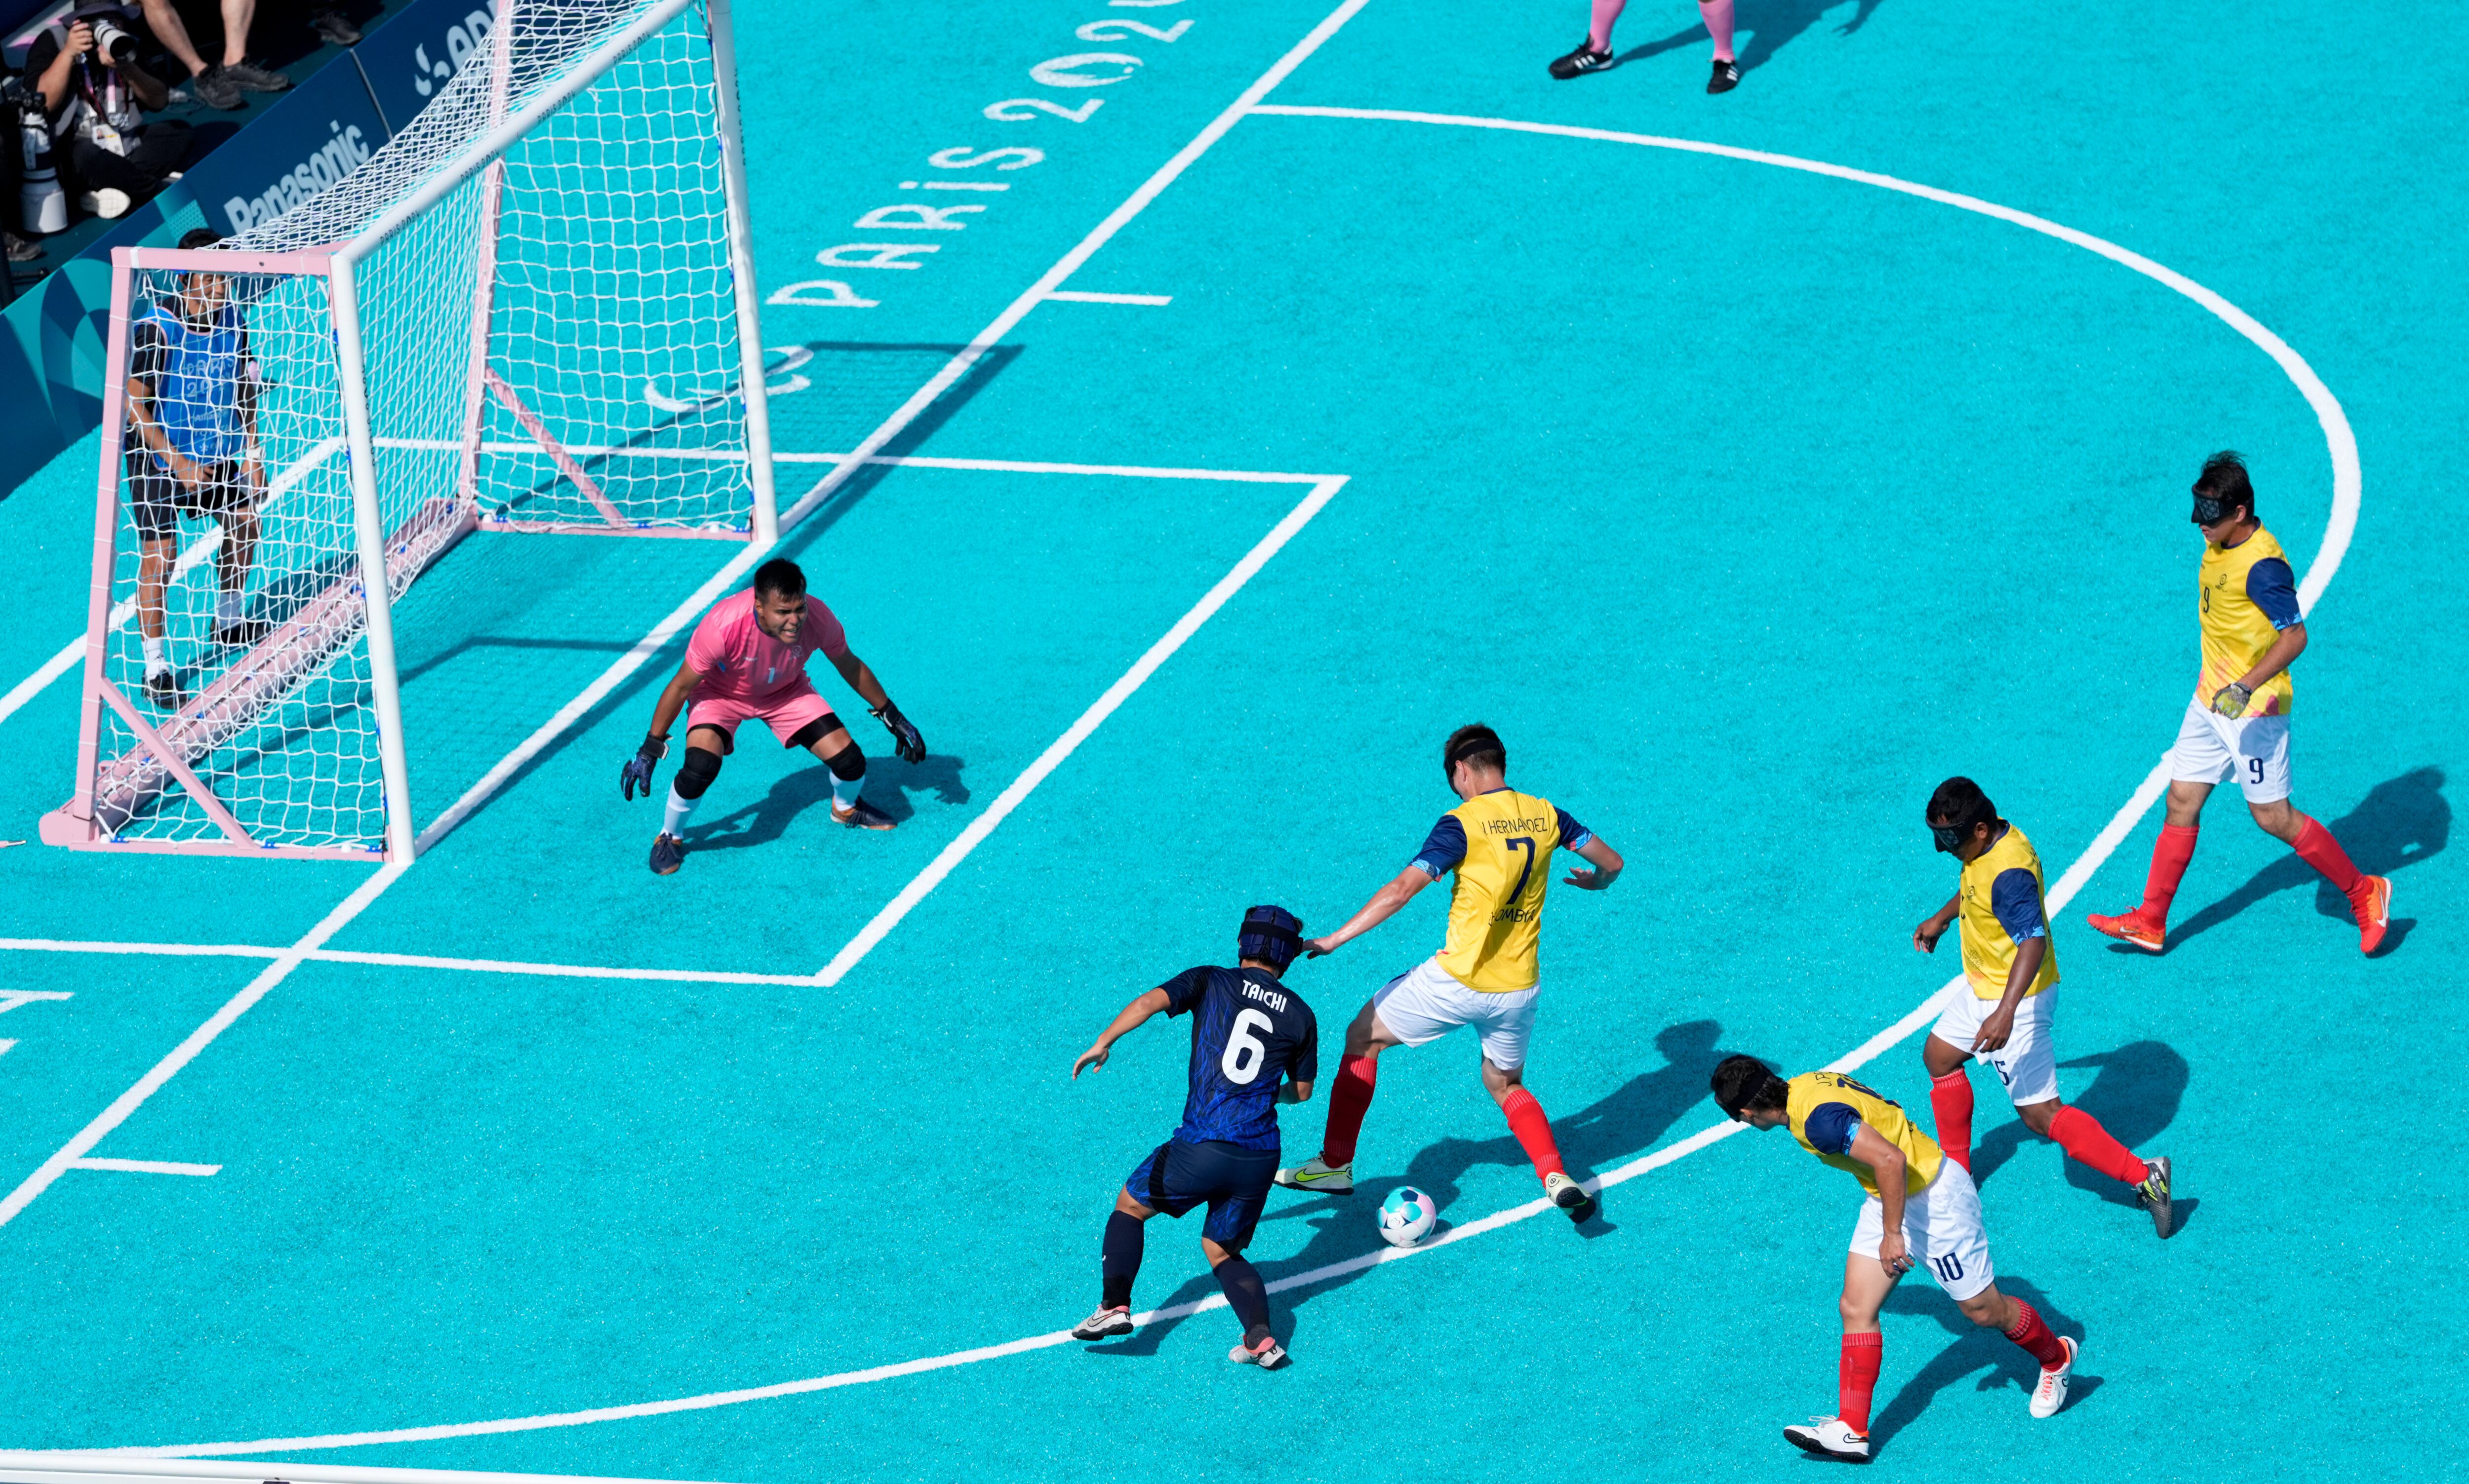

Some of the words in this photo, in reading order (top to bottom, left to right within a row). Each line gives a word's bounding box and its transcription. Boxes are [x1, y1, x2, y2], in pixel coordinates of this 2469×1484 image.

[984, 0, 1195, 123] 202
[224, 120, 369, 243] Panasonic
[2203, 586, 2210, 613] 9
[768, 667, 775, 684] 1
[2249, 758, 2264, 784] 9
[1488, 818, 1548, 834] HERNANDEZ
[1505, 836, 1536, 905] 7
[1242, 979, 1287, 1013] TAICHI
[1222, 1008, 1274, 1085] 6
[1994, 1060, 2010, 1086] 5
[1932, 1251, 1964, 1282] 10
